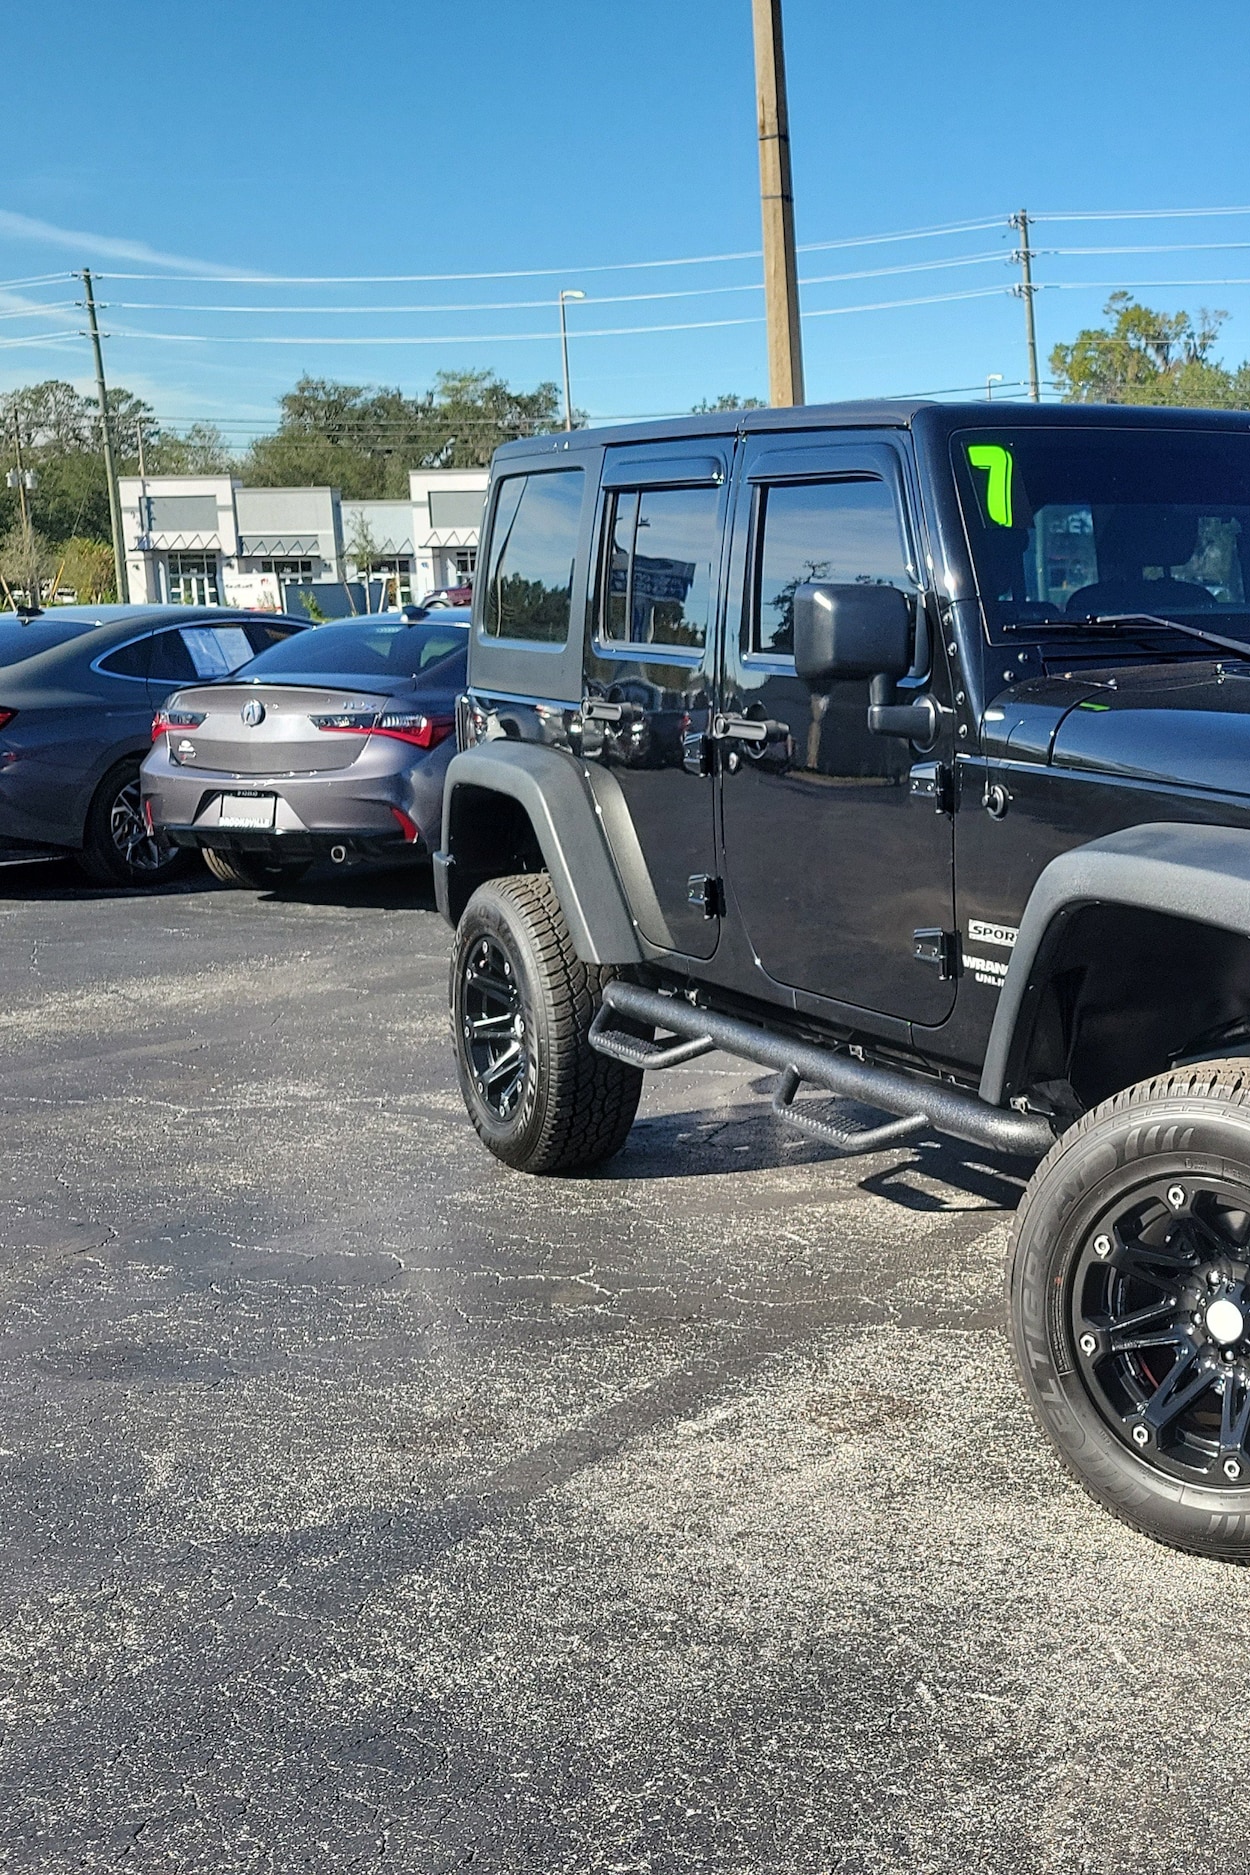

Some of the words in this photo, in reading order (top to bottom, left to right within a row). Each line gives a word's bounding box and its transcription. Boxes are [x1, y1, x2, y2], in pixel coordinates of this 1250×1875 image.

[968, 446, 1012, 527] 7
[972, 925, 1018, 941] SPOR
[962, 954, 1009, 976] WRAN
[975, 972, 1005, 987] UNLI
